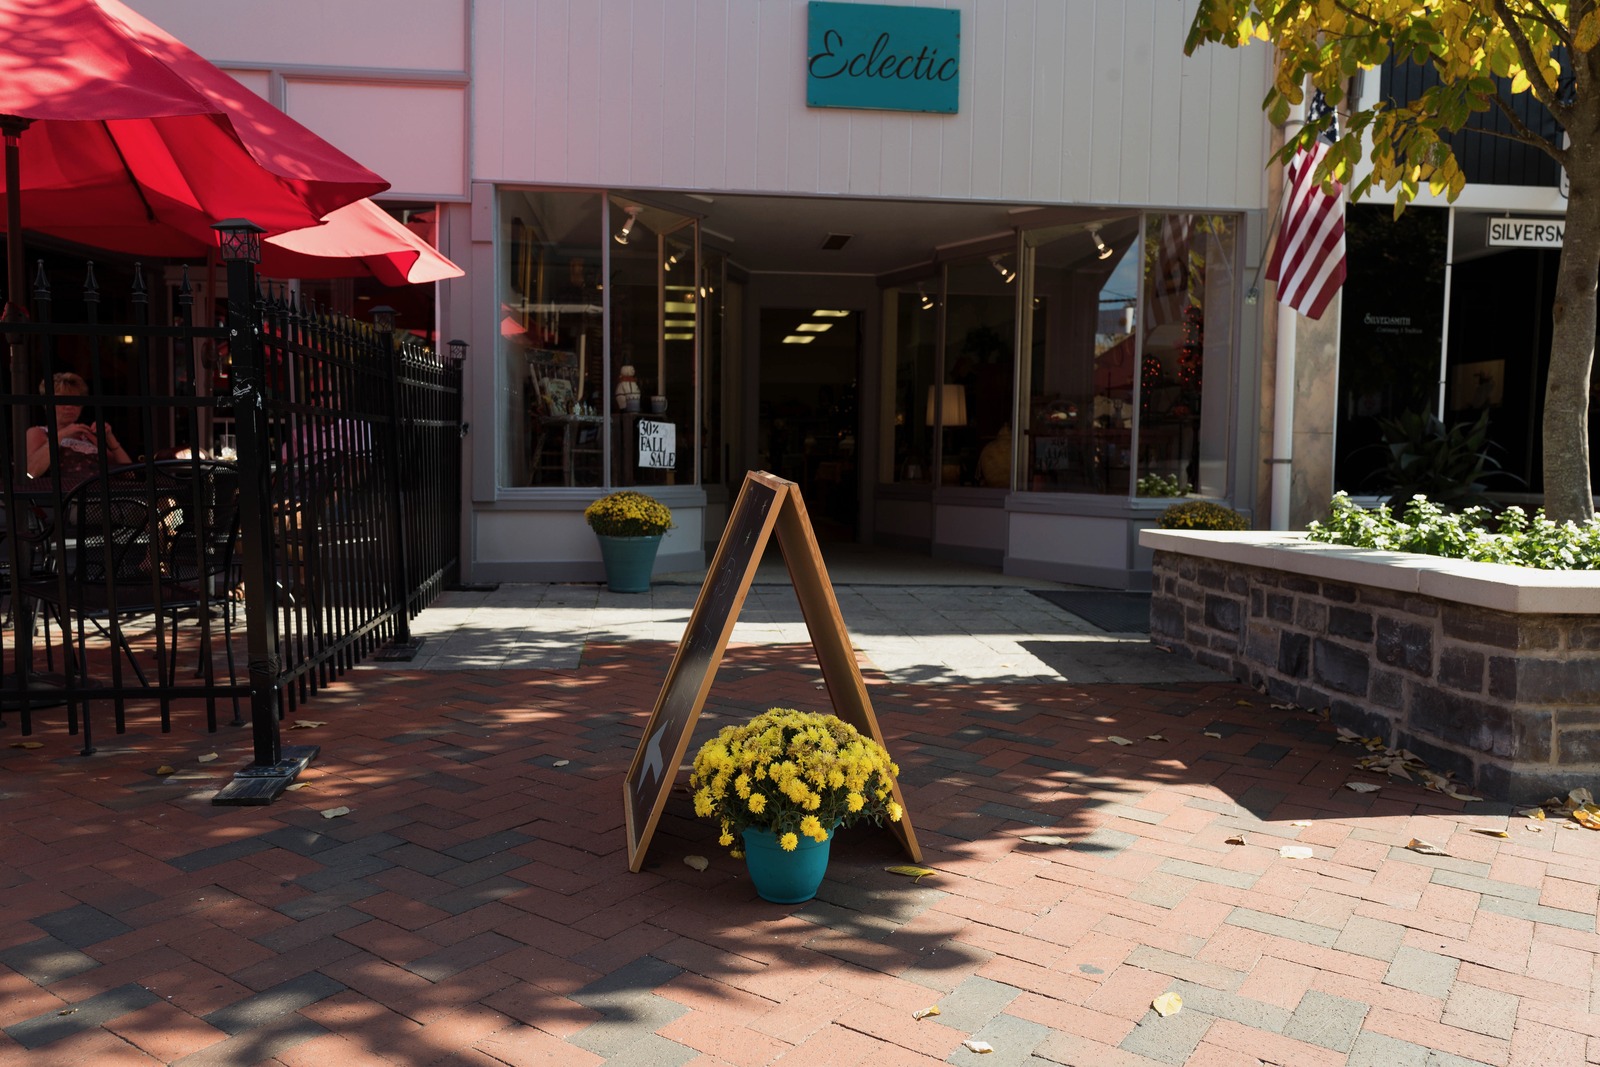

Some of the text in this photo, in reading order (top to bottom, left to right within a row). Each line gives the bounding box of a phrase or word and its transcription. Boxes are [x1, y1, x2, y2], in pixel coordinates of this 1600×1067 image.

[809, 29, 959, 81] Eclectic
[640, 421, 659, 436] 30%
[640, 436, 665, 452] FALL
[649, 449, 676, 467] SALE
